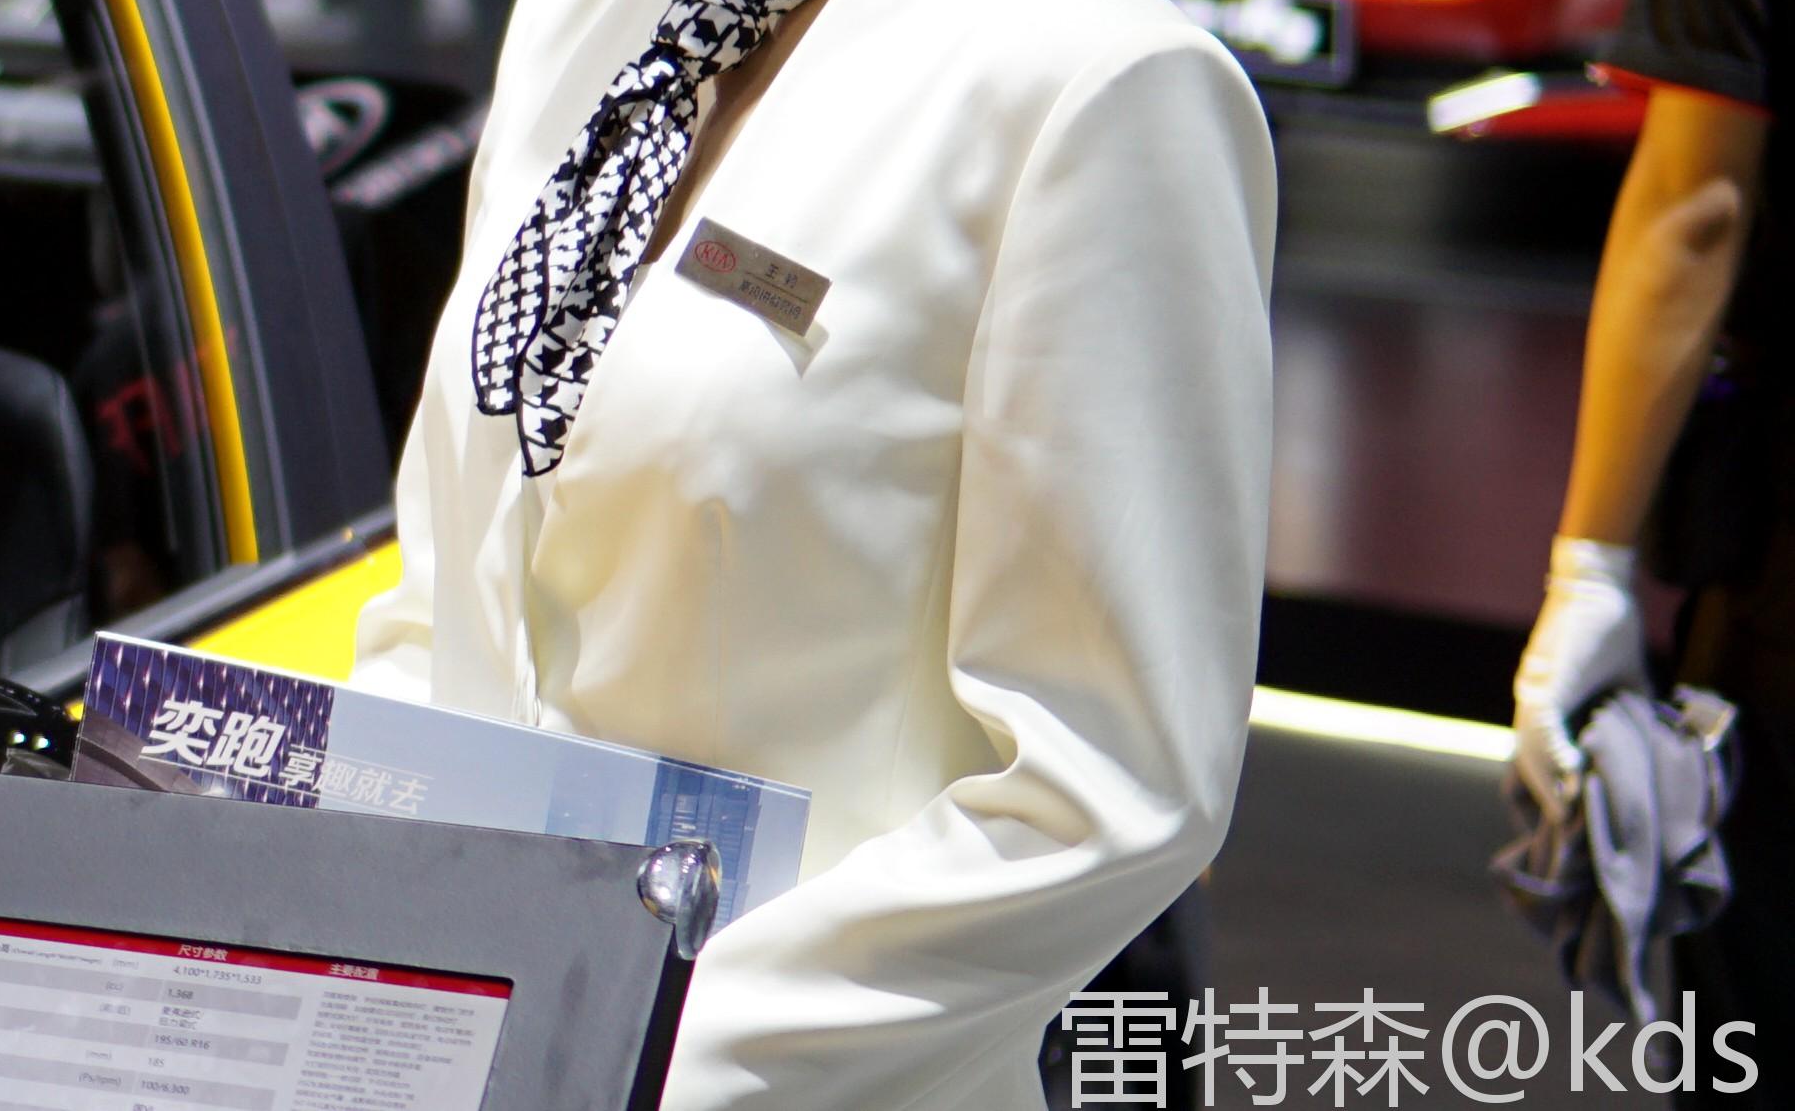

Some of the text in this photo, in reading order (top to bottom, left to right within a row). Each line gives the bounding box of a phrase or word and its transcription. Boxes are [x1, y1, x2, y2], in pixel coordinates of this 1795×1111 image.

[700, 243, 730, 270] KIA
[141, 699, 429, 816] 奕跑 享趣就去
[178, 944, 229, 961] 尺寸参数
[327, 963, 380, 980] 主要配置
[168, 988, 193, 1000] 1,368
